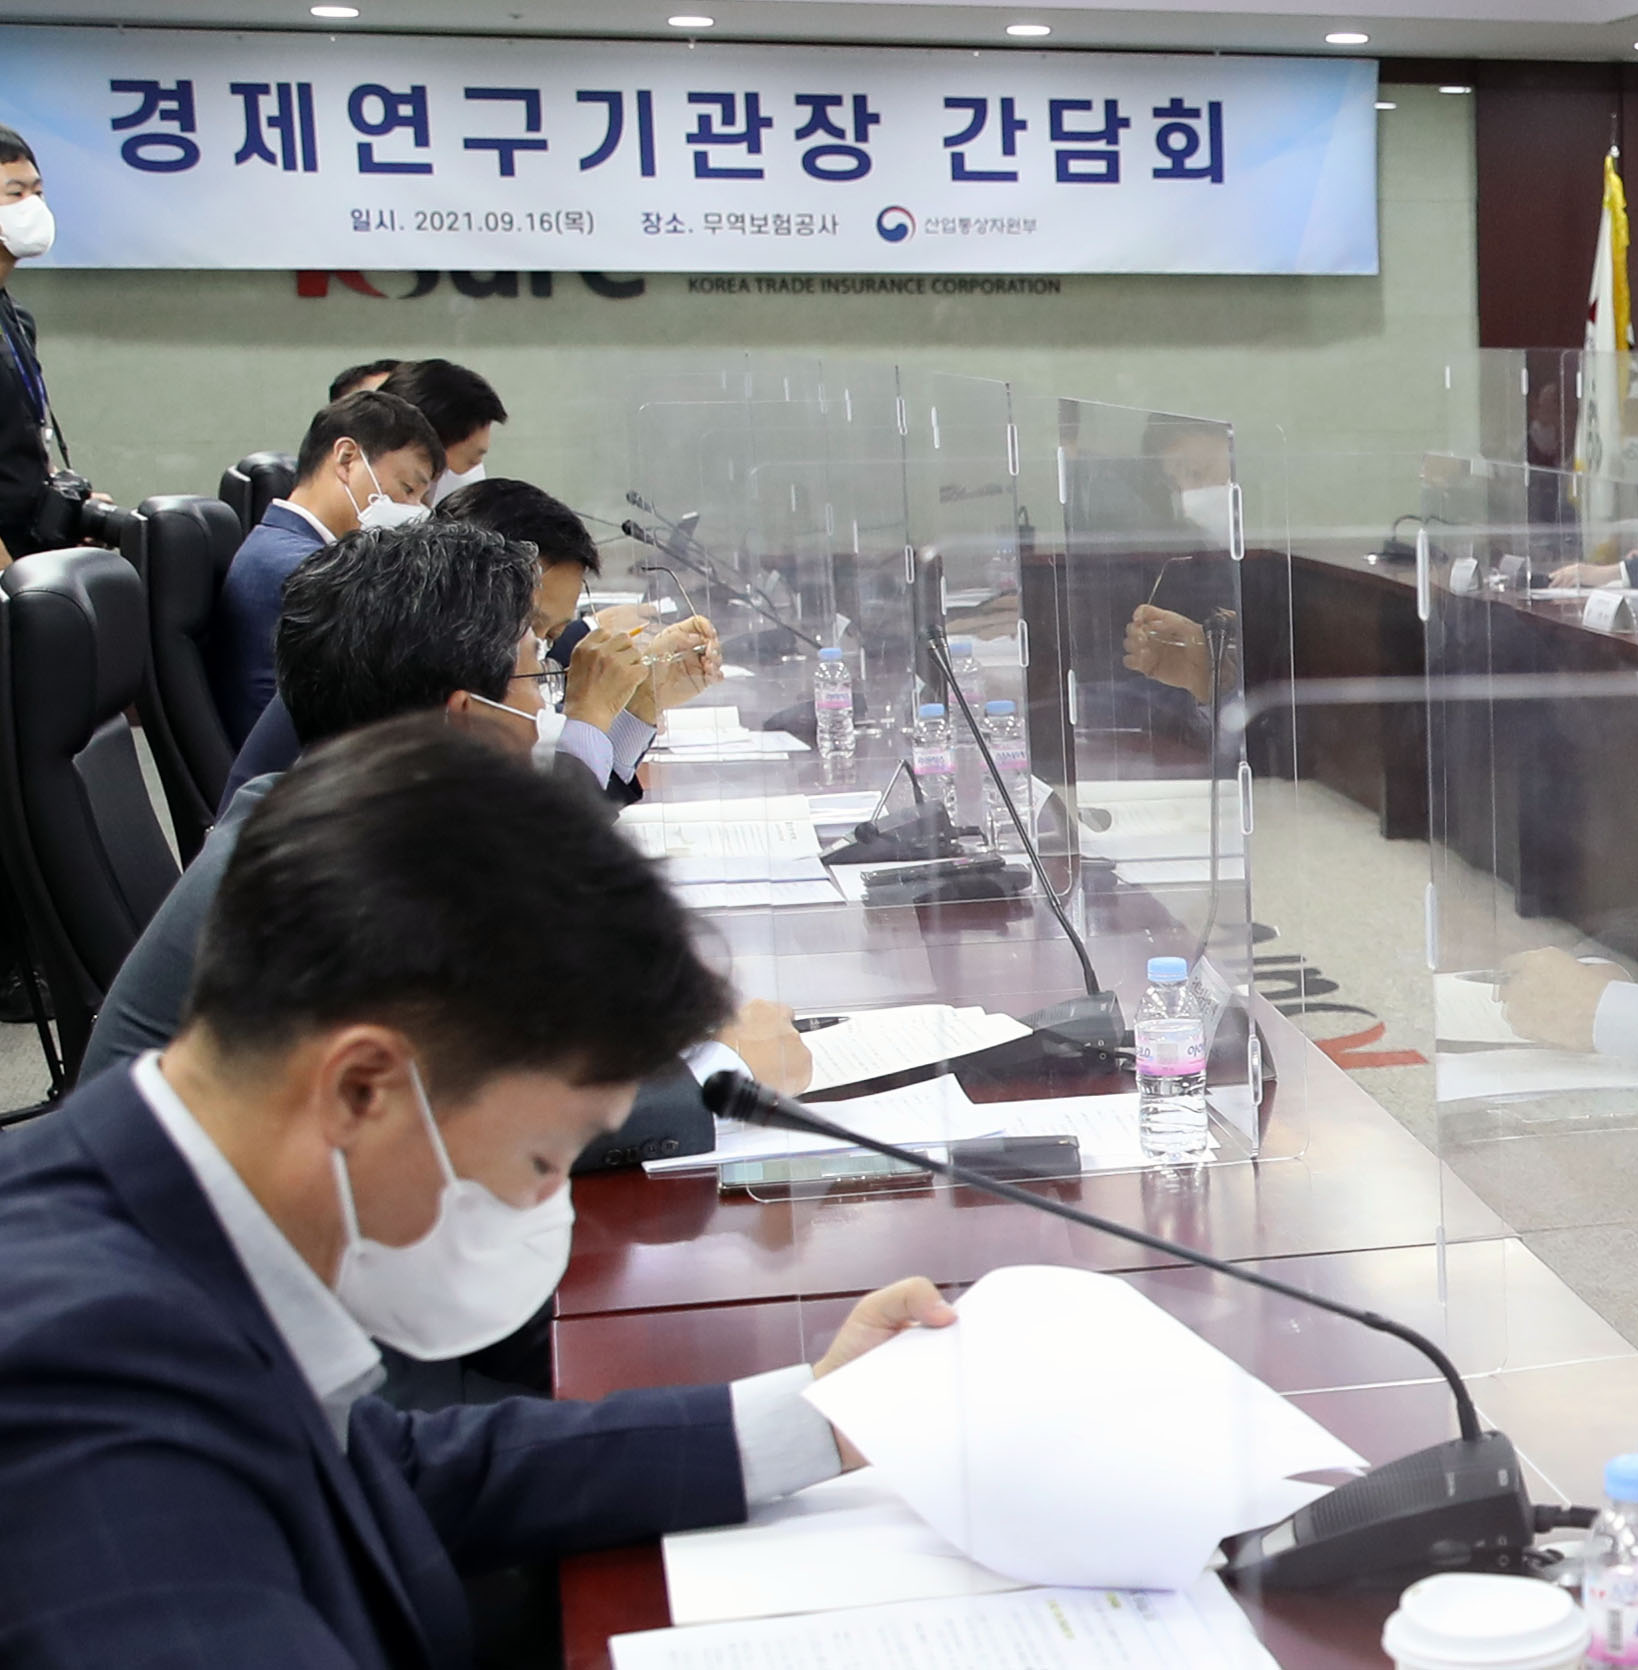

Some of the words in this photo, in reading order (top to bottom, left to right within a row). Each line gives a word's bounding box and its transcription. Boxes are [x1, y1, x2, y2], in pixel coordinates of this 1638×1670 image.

[109, 78, 881, 181] 경제연구기관장
[943, 97, 1224, 184] 간담회
[350, 208, 405, 232] 일시.
[415, 210, 594, 235] 2021.09.16(목)
[641, 212, 694, 236] 장소.
[703, 212, 840, 236] 무역보험공사
[924, 217, 1038, 235] 산업통상자원부
[688, 278, 749, 296] KOREA
[755, 278, 815, 296] TRADE
[821, 278, 925, 297] INSURANCE
[931, 278, 1061, 298] CORPORATION
